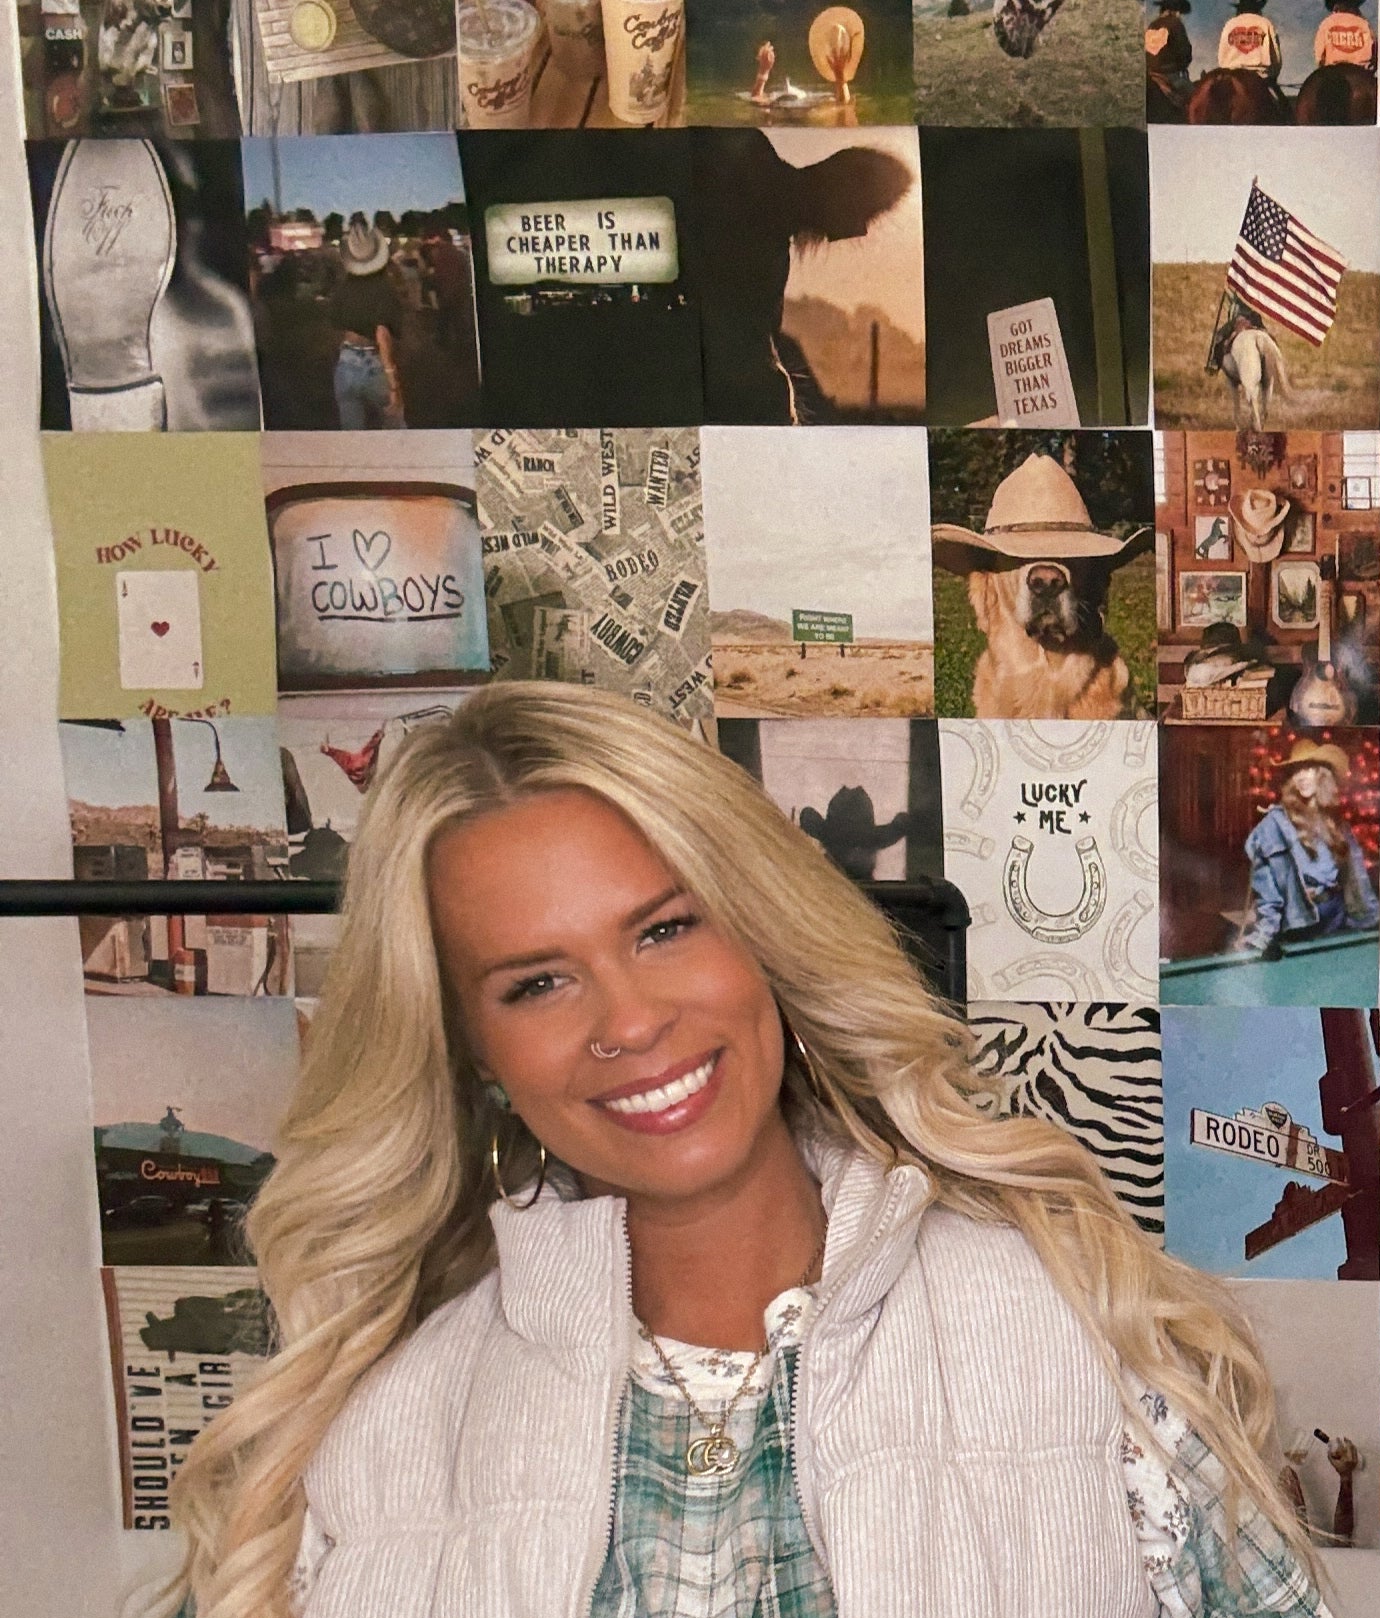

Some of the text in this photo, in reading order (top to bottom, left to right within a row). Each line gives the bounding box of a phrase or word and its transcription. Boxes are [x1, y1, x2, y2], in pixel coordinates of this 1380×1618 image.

[45, 29, 82, 41] CASH
[521, 211, 615, 232] BEER IS
[506, 231, 661, 254] CHEAPER THAN
[534, 255, 622, 274] THERAPY
[1010, 319, 1033, 336] GOT
[1000, 333, 1051, 358] DREAMS
[1005, 353, 1052, 376] BIGGER
[1014, 372, 1050, 393] THAN
[1013, 392, 1057, 415] TEXAS
[600, 431, 618, 531] WILD WEST
[96, 528, 220, 573] HOW LUCKY
[306, 534, 338, 570] I
[605, 549, 660, 583] RODEO
[311, 574, 464, 616] COWBOYS
[664, 579, 699, 633] WANTED
[589, 612, 646, 666] COWBOY
[671, 671, 708, 709] WEST
[1021, 779, 1088, 808] LUCKY
[1039, 810, 1072, 834] ME
[1206, 1117, 1280, 1158] RODEO
[1307, 1143, 1321, 1157] DR
